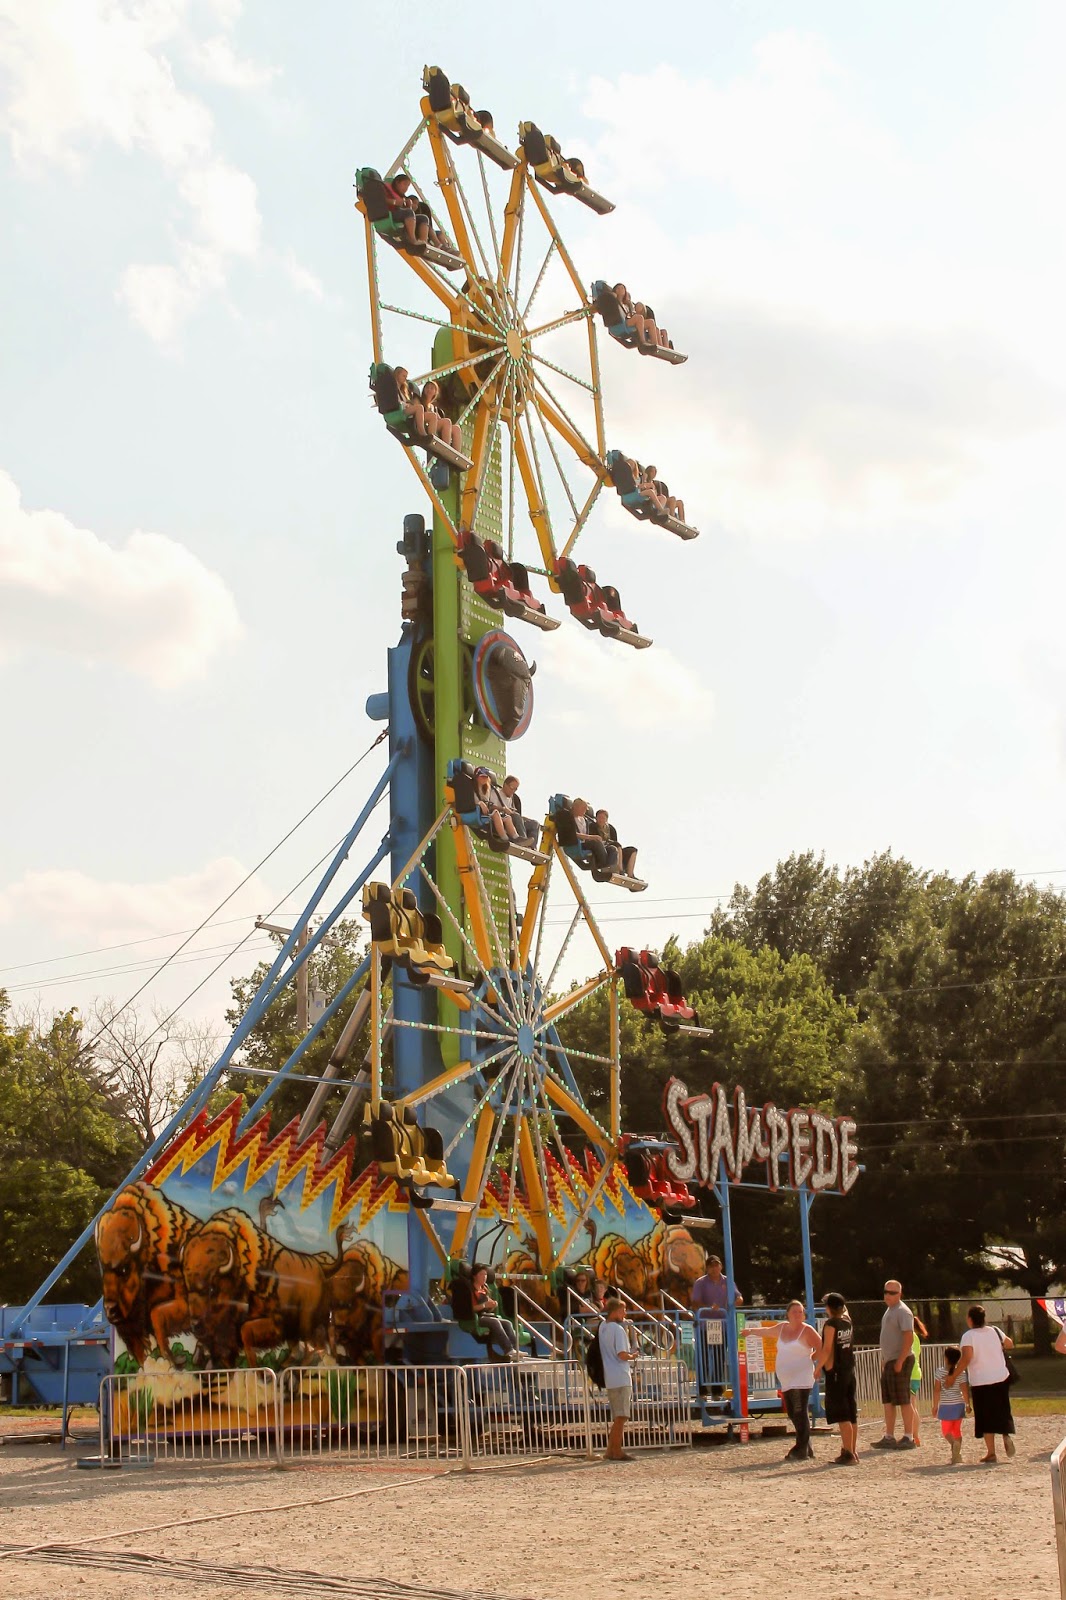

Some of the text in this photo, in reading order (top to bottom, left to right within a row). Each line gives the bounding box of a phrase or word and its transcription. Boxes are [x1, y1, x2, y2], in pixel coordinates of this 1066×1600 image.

[662, 1076, 860, 1195] STAMPEDE
[707, 1321, 721, 1331] ENTER
[708, 1333, 721, 1343] HERE
